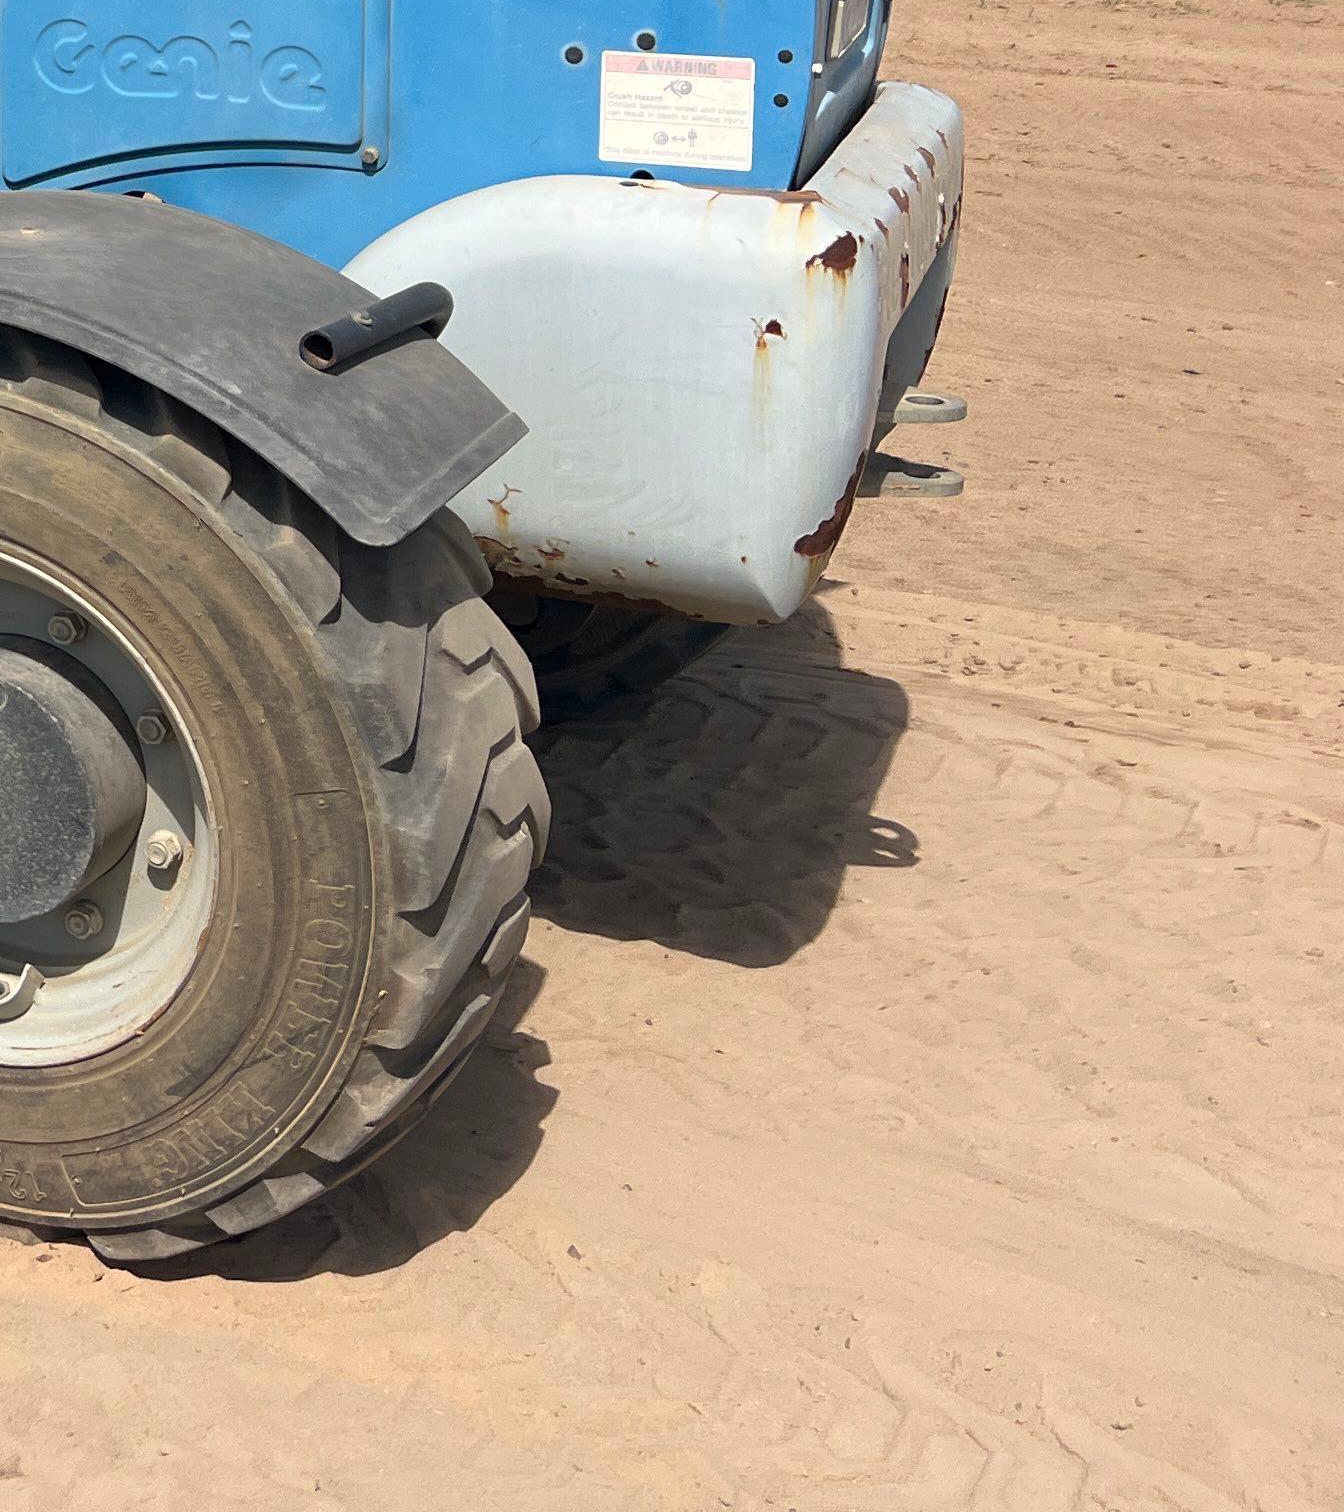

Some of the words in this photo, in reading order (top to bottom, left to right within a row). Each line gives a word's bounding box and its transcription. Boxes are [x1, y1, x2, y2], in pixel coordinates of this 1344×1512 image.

[33, 18, 328, 112] Genie
[651, 60, 718, 76] WARNING
[264, 879, 355, 1070] POWER
[145, 1082, 276, 1176] KING
